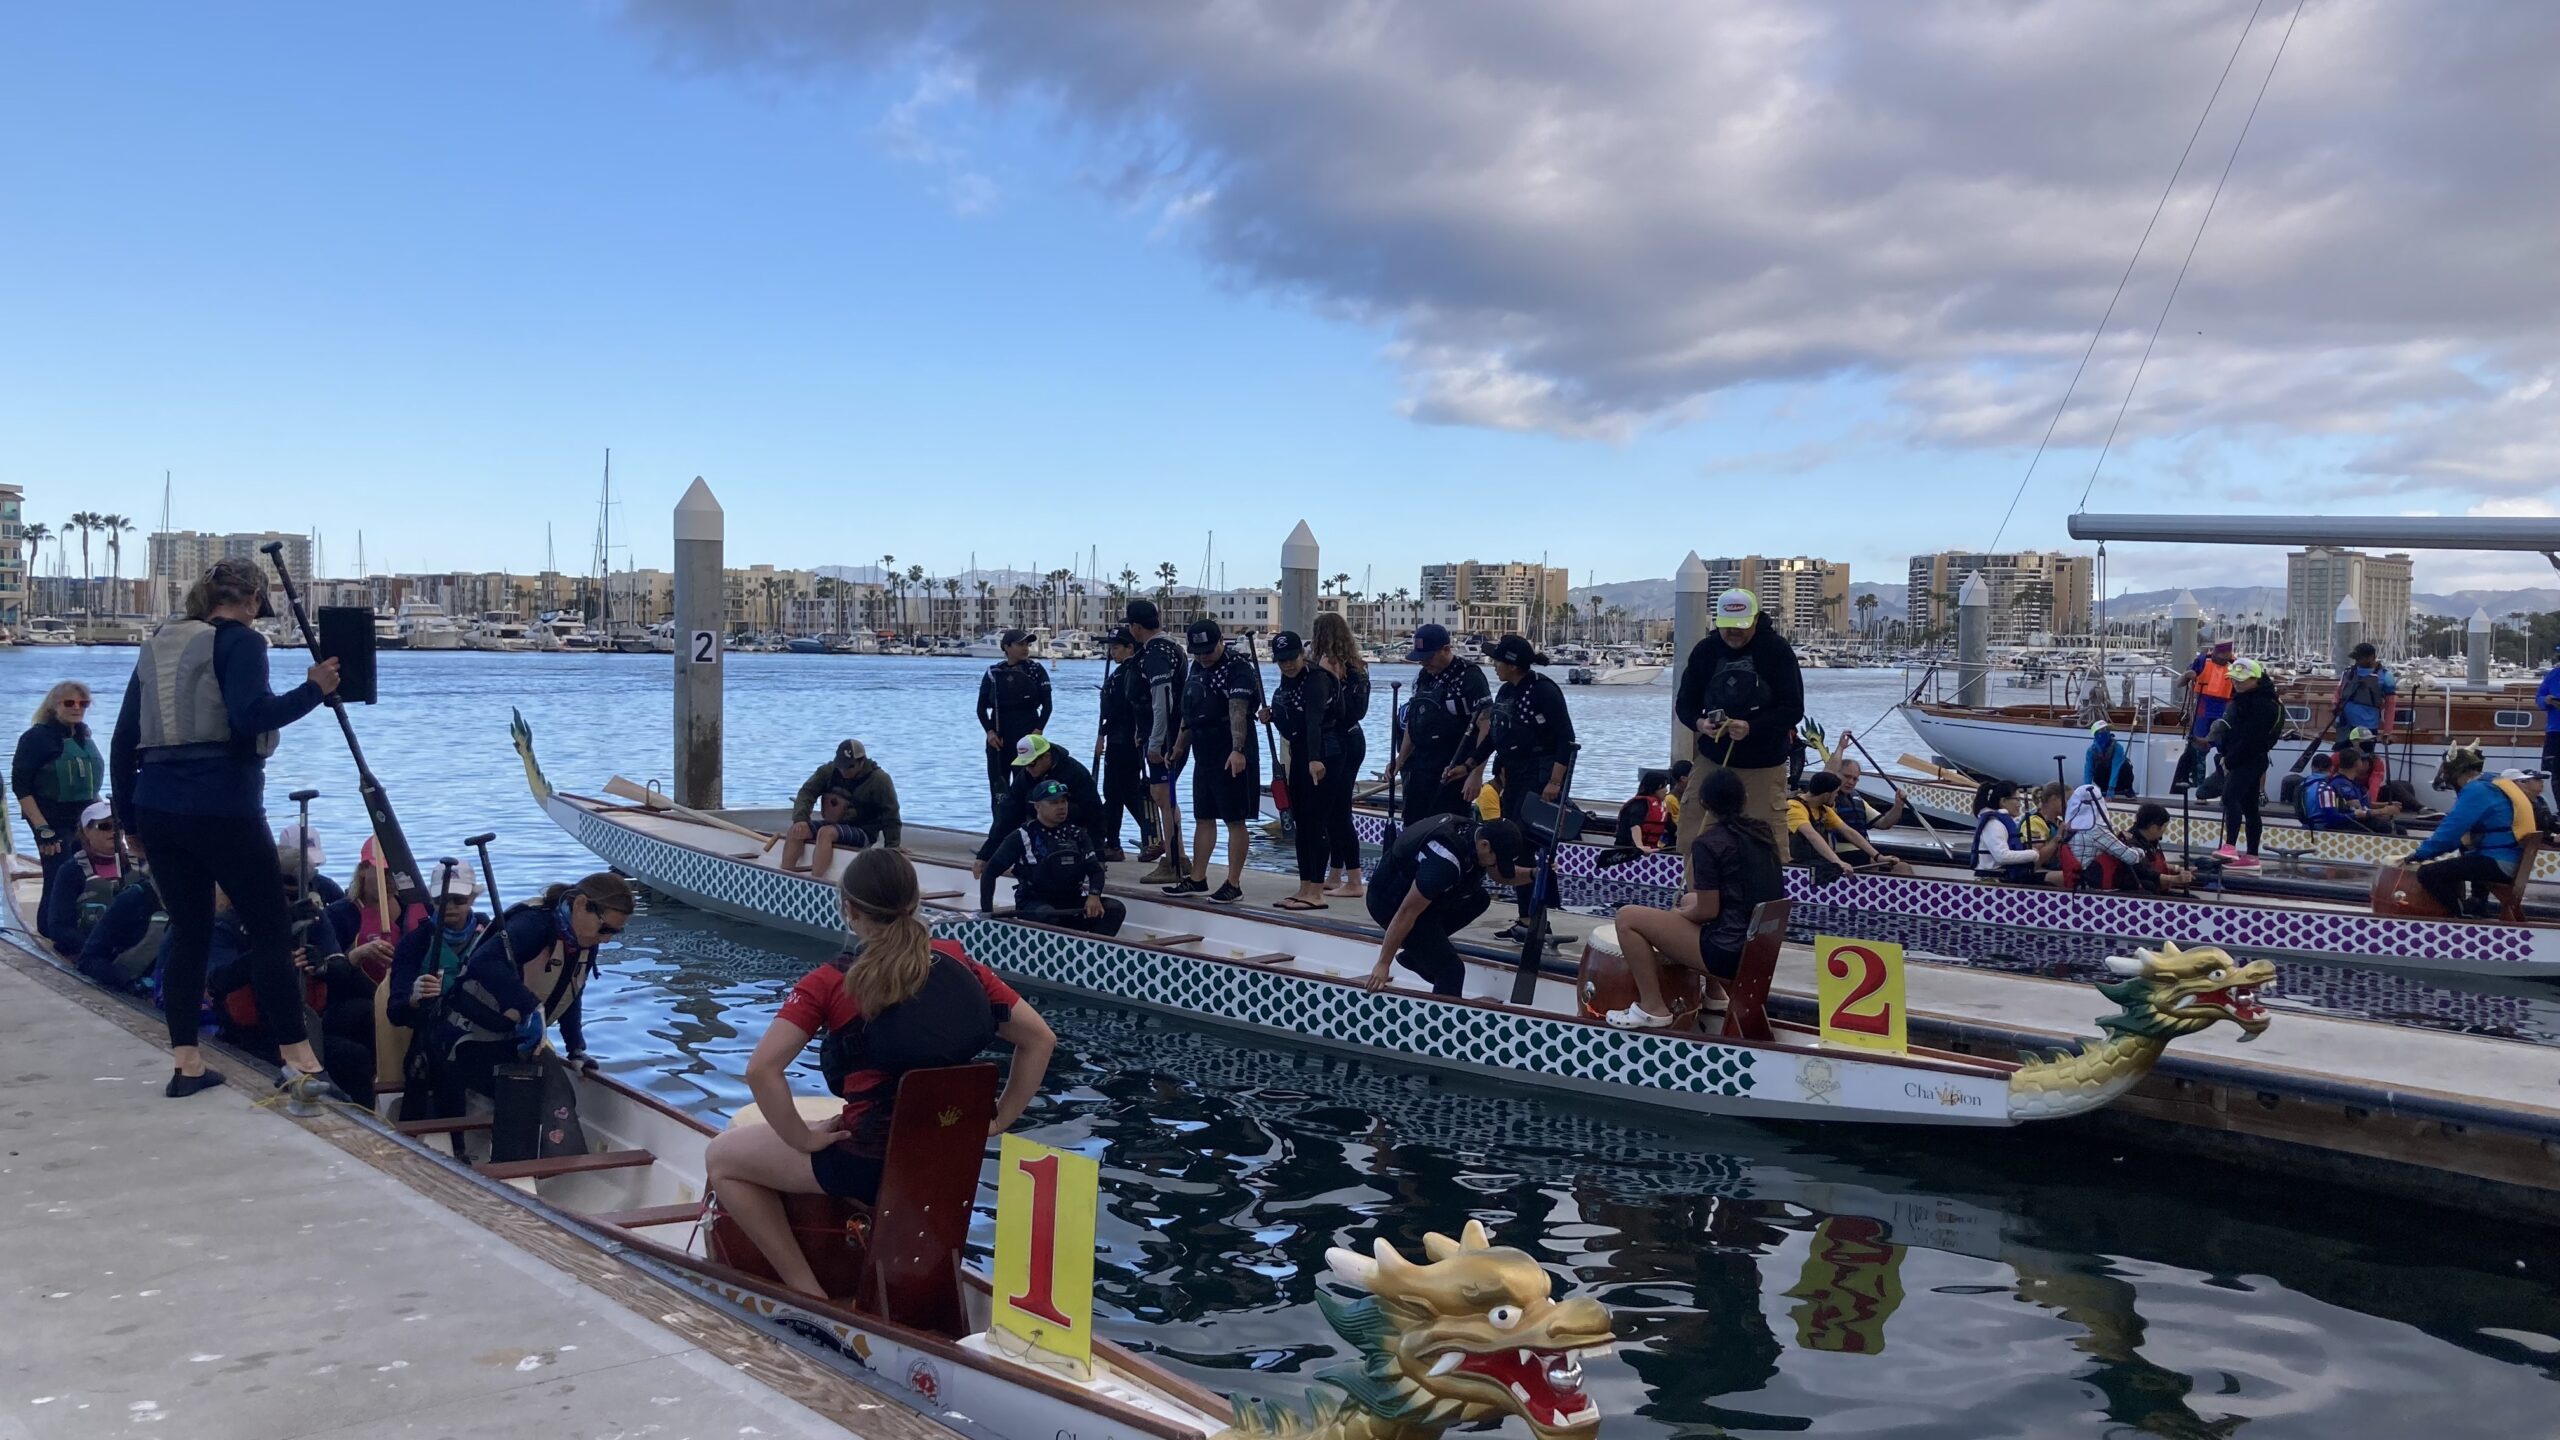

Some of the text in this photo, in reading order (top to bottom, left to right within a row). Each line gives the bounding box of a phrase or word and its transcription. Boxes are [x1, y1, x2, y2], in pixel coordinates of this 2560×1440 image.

[696, 632, 713, 662] 2
[1827, 944, 1891, 1037] 2
[1904, 1082, 1982, 1107] Chapion
[1009, 1153, 1072, 1329] 1
